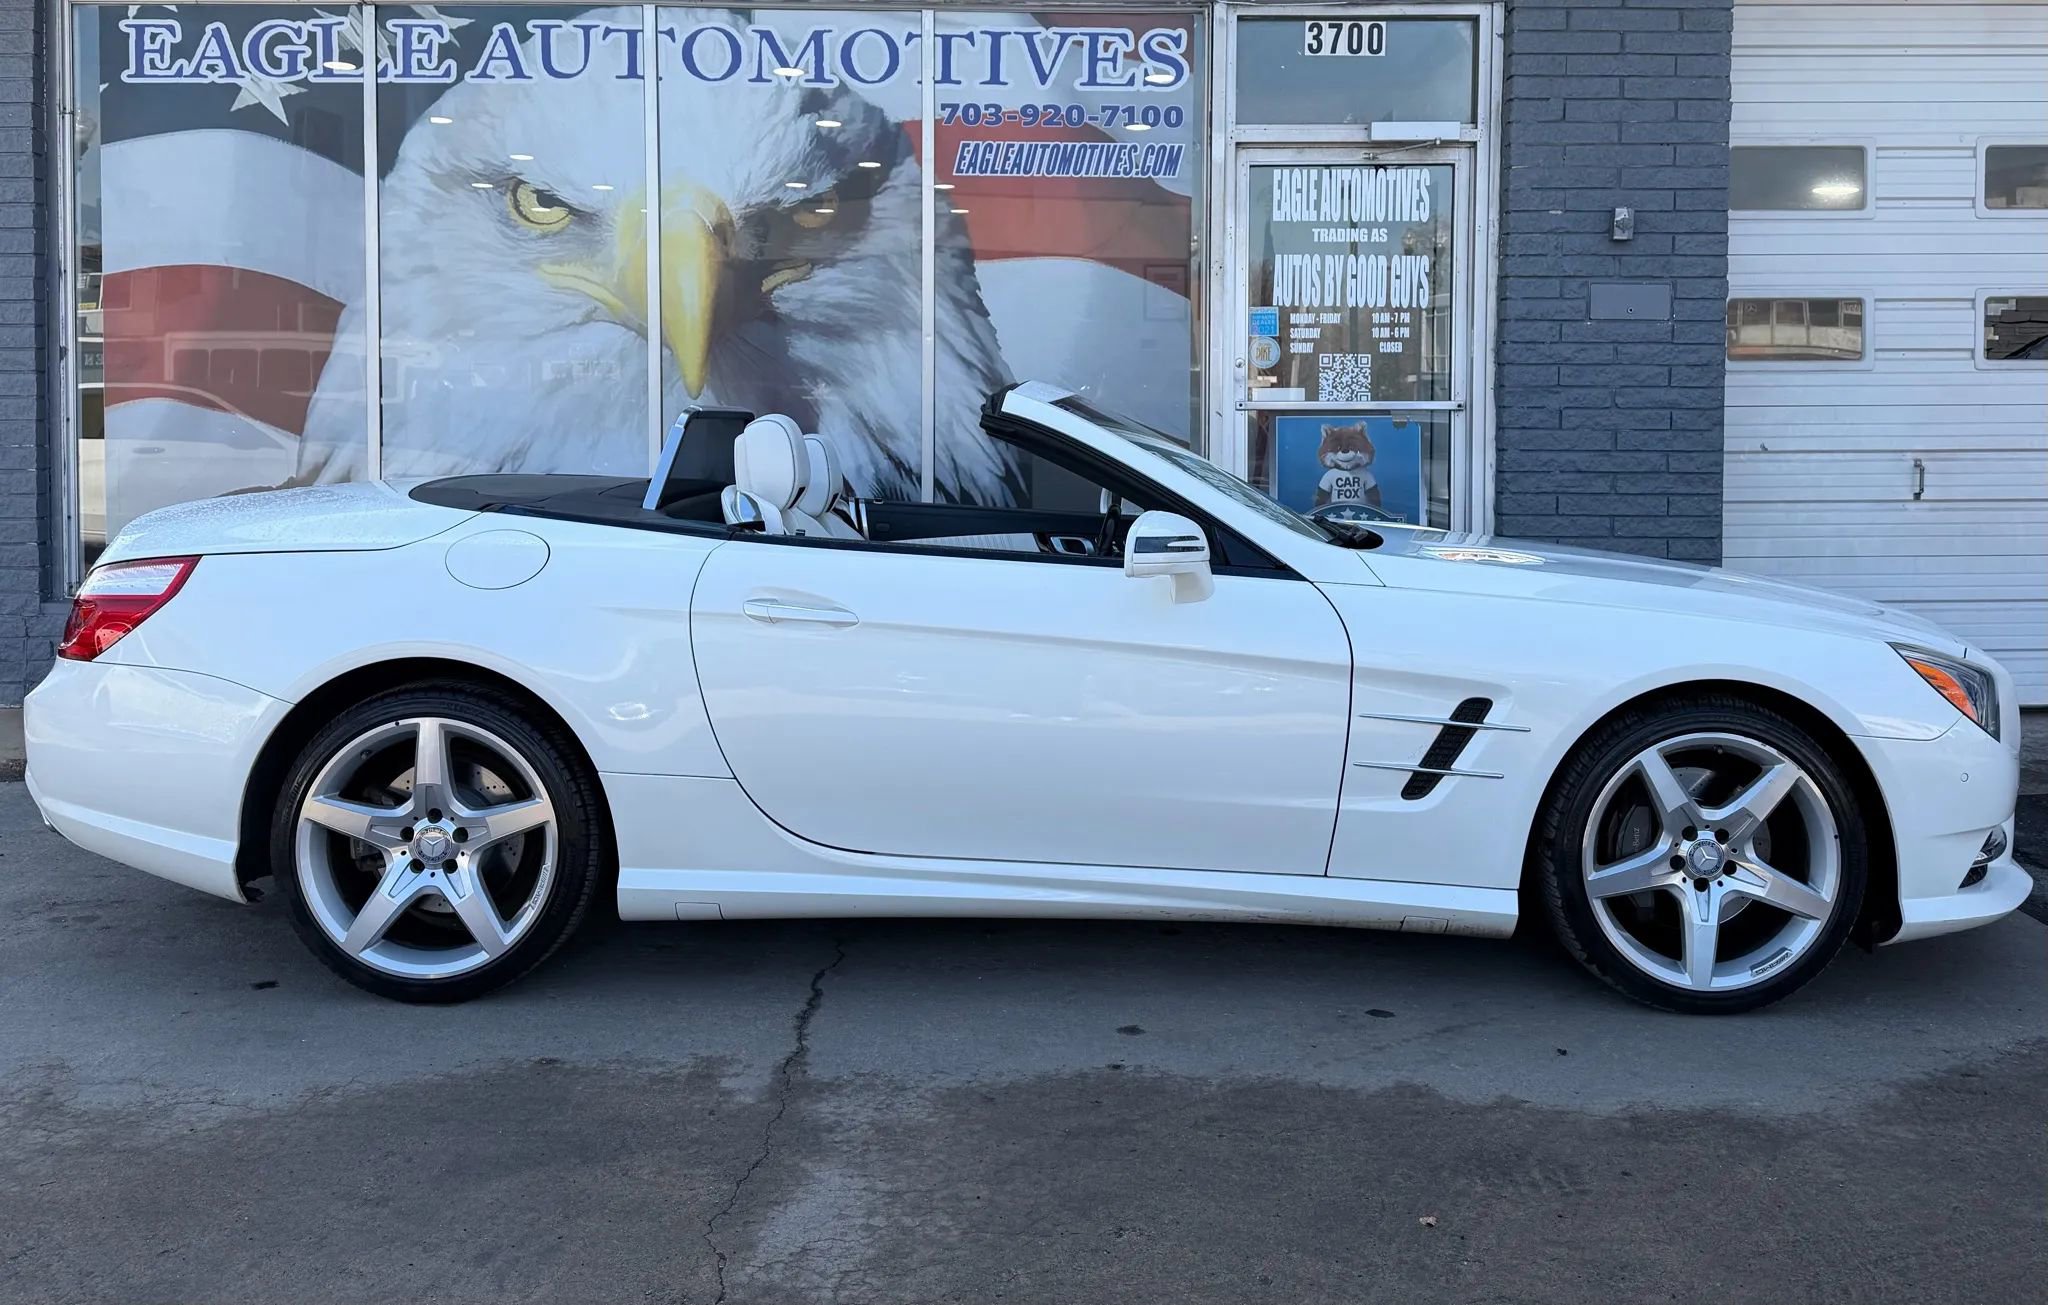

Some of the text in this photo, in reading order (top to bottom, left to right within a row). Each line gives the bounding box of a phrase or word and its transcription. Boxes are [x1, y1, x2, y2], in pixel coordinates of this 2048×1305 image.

[1307, 22, 1384, 55] 3700
[121, 19, 1189, 89] EAGLE AUTOMOTIVES
[940, 103, 1184, 128] 703-920-7100
[954, 142, 1184, 177] EAGLEAUTOMOTIVES.COM
[1273, 168, 1430, 222] EAGLE AUTOMOTIVES
[1312, 228, 1388, 242] TRADING AS
[1273, 254, 1429, 309] AUTOS BY GOOD GUYS
[1290, 313, 1315, 324] MONDAY
[1320, 313, 1341, 324] FRIDAY
[1372, 312, 1379, 324] 10
[1380, 312, 1390, 324] AM
[1400, 312, 1410, 323] PM
[1290, 328, 1321, 339] SATURDAY
[1372, 327, 1379, 338] 10
[1380, 327, 1390, 338] AM
[1400, 327, 1410, 338] PM
[1290, 342, 1402, 353] SUNDAY CLOSED
[1336, 476, 1360, 488] CAR
[1337, 489, 1360, 499] FOX
